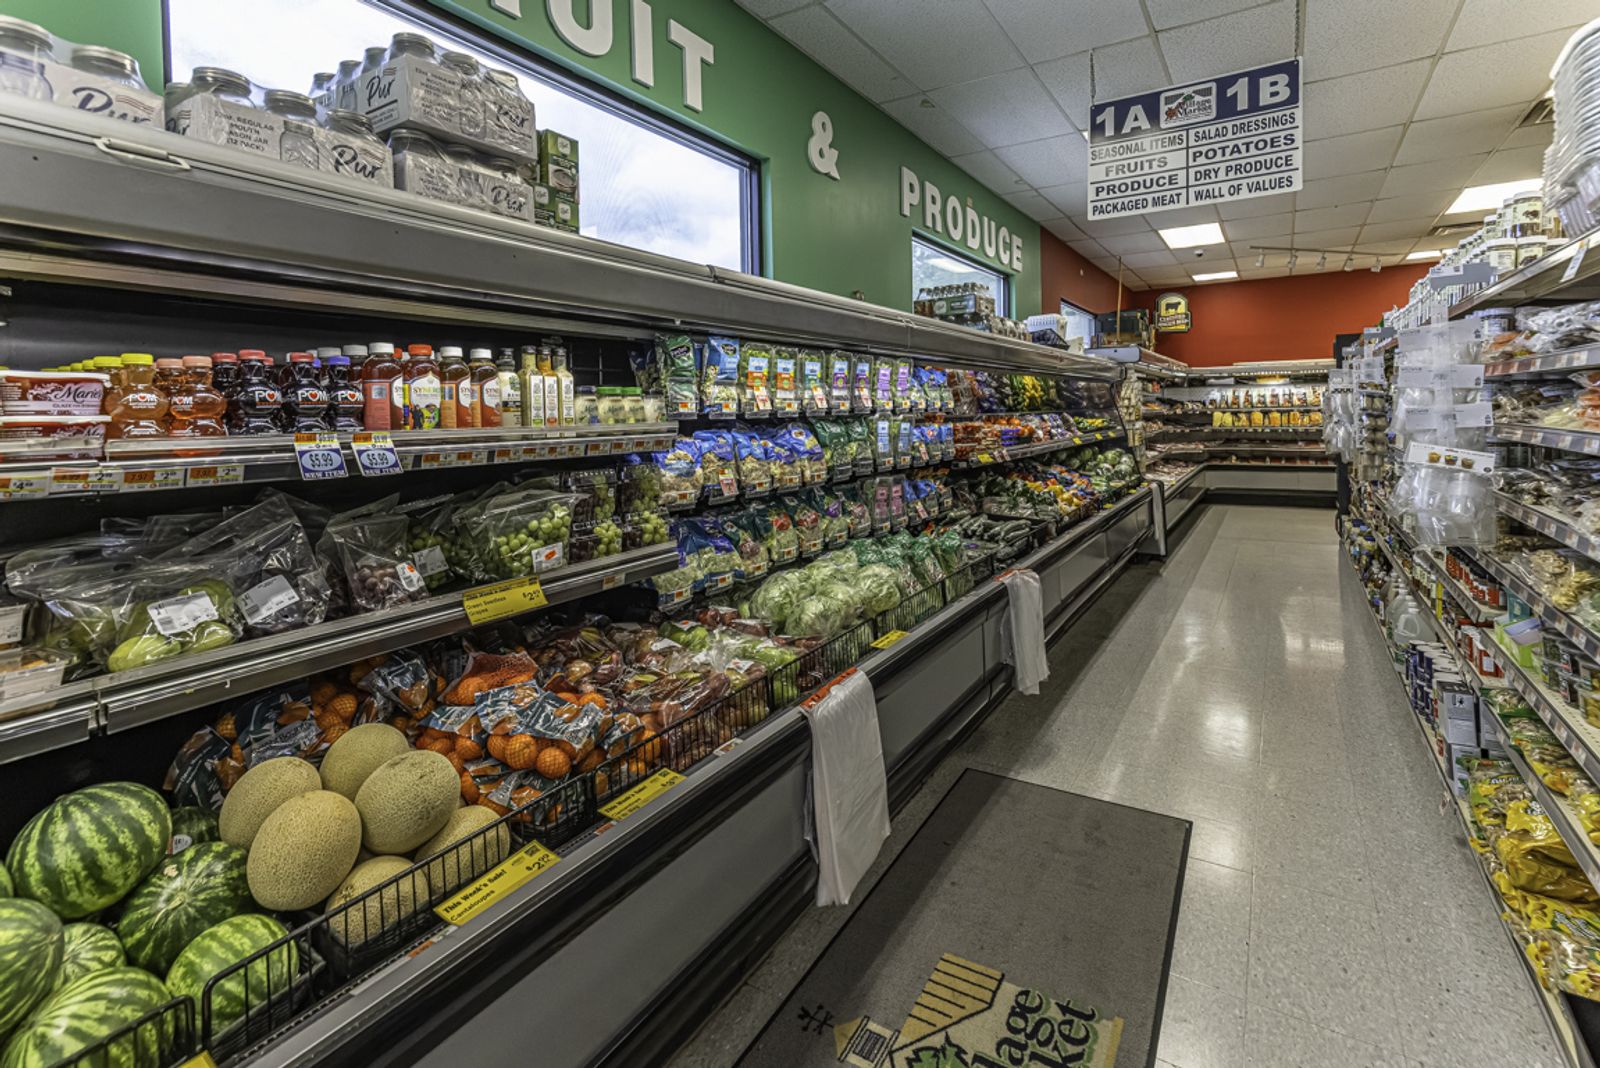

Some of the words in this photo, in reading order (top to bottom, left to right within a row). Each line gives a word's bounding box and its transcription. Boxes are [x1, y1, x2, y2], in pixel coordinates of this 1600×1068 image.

[490, 0, 714, 112] UIT
[367, 74, 396, 107] Pur
[1226, 73, 1292, 112] 1B
[229, 122, 261, 136] MOUTH
[237, 116, 274, 131] REGULAR
[1095, 104, 1152, 138] 1A
[1194, 126, 1229, 143] SALAD
[1231, 111, 1296, 136] DRESSINGS
[228, 132, 251, 142] ASON
[254, 136, 269, 145] JAR
[807, 110, 841, 181] &
[1091, 142, 1147, 161] SEASONAL
[1150, 133, 1185, 150] ITEMS
[1192, 133, 1296, 163] POTATOES
[331, 144, 383, 180] Pur
[1105, 156, 1169, 177] FRUITS
[1194, 167, 1222, 183] DRY
[1225, 154, 1294, 178] PRODUCE
[1095, 173, 1180, 198] PRODUCE
[1194, 184, 1225, 202] WALL
[1227, 182, 1244, 197] OF
[1246, 175, 1294, 194] VALUES
[1092, 197, 1149, 217] PACKAGED
[1152, 192, 1183, 209] MEAT
[900, 166, 1024, 273] PRODUCE
[297, 390, 328, 403] POM
[309, 452, 334, 468] $5.99
[366, 452, 389, 466] $5.99
[442, 900, 462, 915] This
[460, 883, 490, 902] Week's
[488, 869, 508, 885] Sale!
[450, 890, 496, 922] Cantaloupes
